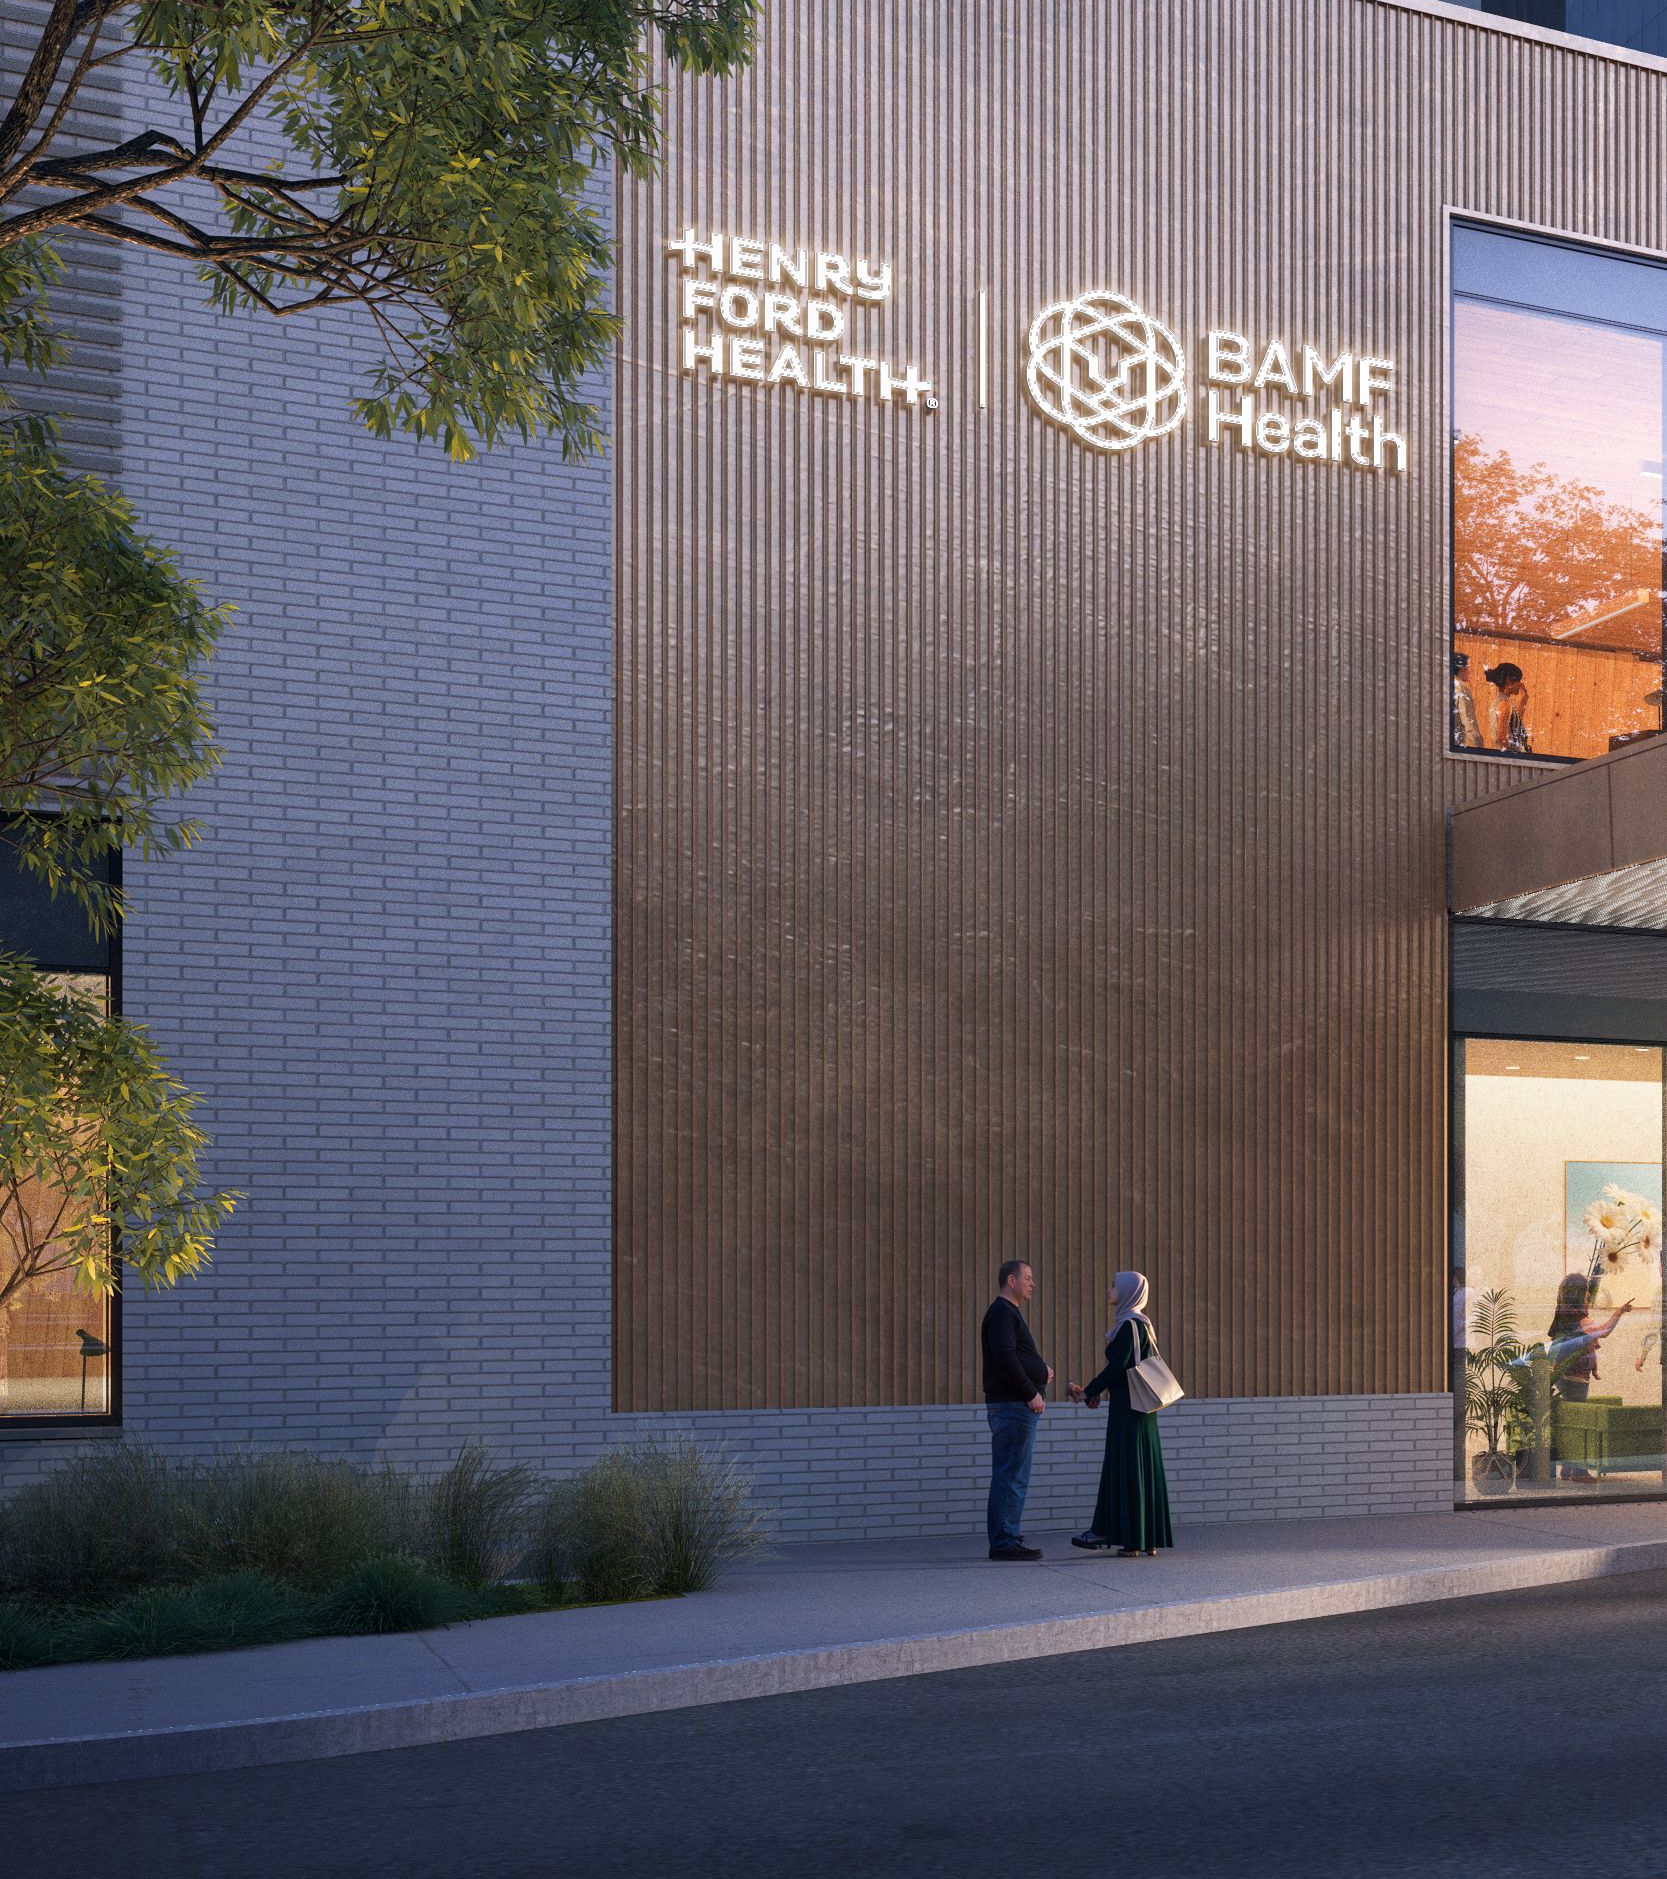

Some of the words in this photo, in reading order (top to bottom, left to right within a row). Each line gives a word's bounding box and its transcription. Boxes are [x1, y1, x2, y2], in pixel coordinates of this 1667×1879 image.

[668, 228, 892, 300] HENRY
[683, 278, 845, 341] FORD
[1208, 329, 1394, 406] BAMF
[1208, 390, 1407, 472] Health
